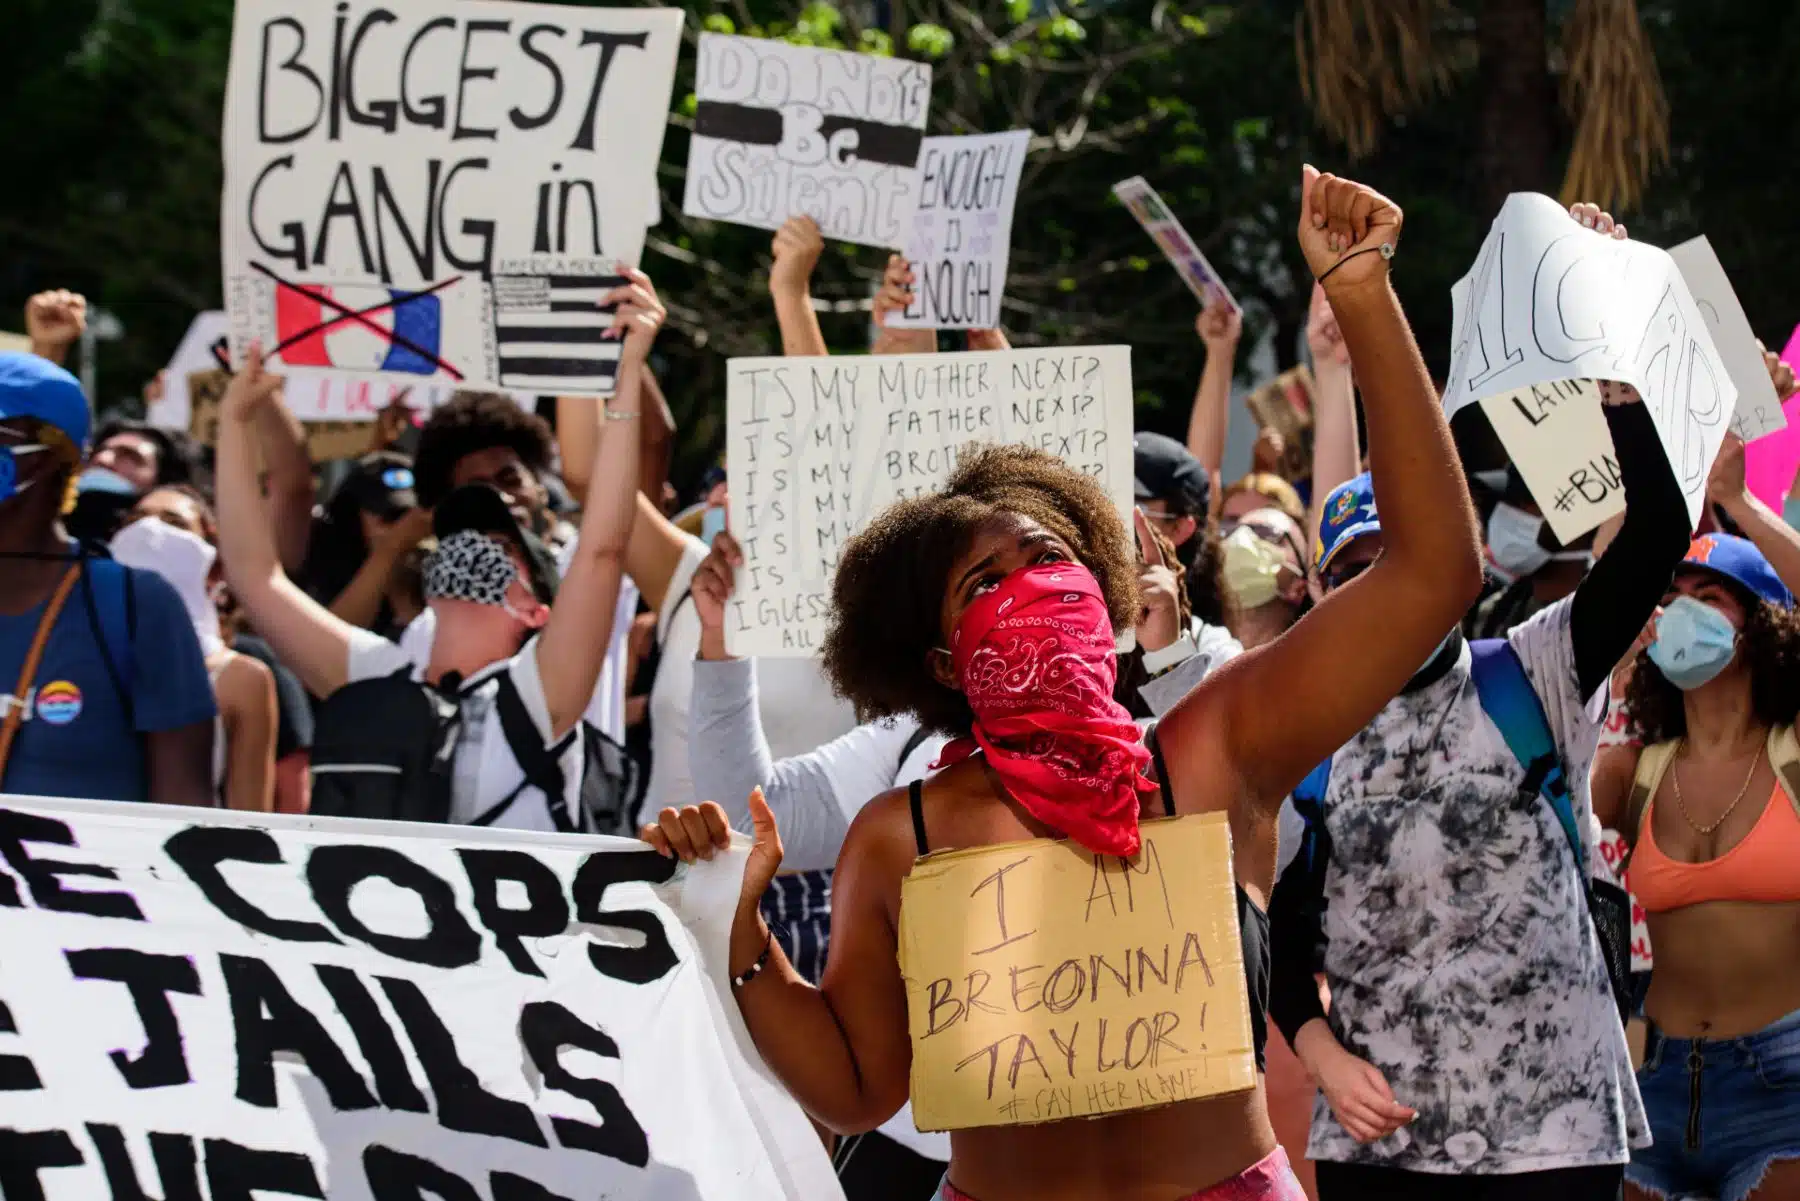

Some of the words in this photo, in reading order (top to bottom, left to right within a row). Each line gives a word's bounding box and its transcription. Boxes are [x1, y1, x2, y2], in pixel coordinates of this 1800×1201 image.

[775, 101, 860, 170] Be
[698, 141, 910, 241] Silent
[918, 141, 1014, 210] ENOUGH
[248, 155, 495, 283] GANG
[532, 163, 601, 254] in
[904, 258, 991, 323] ENOUGH
[738, 367, 796, 425] IS
[812, 366, 859, 416] MY
[879, 360, 990, 404] MOTHER
[1012, 355, 1100, 391] NEXT?
[745, 431, 793, 462] IS
[815, 422, 854, 450] MY
[888, 405, 992, 435] FATHER
[1012, 394, 1095, 425] NEXT?
[746, 468, 788, 496] IS
[812, 463, 852, 486] MY
[746, 500, 785, 529] IS
[815, 491, 852, 513] MY
[745, 532, 787, 561] IS
[749, 565, 785, 591] IS
[732, 600, 752, 632] I
[757, 592, 832, 628] GUESS
[163, 824, 683, 984] COPS
[970, 855, 1037, 956] I
[1085, 838, 1175, 930] AM
[920, 932, 1215, 1041] BREONNA
[62, 946, 650, 1169] JAILS
[955, 1001, 1209, 1100] TAYLOR!
